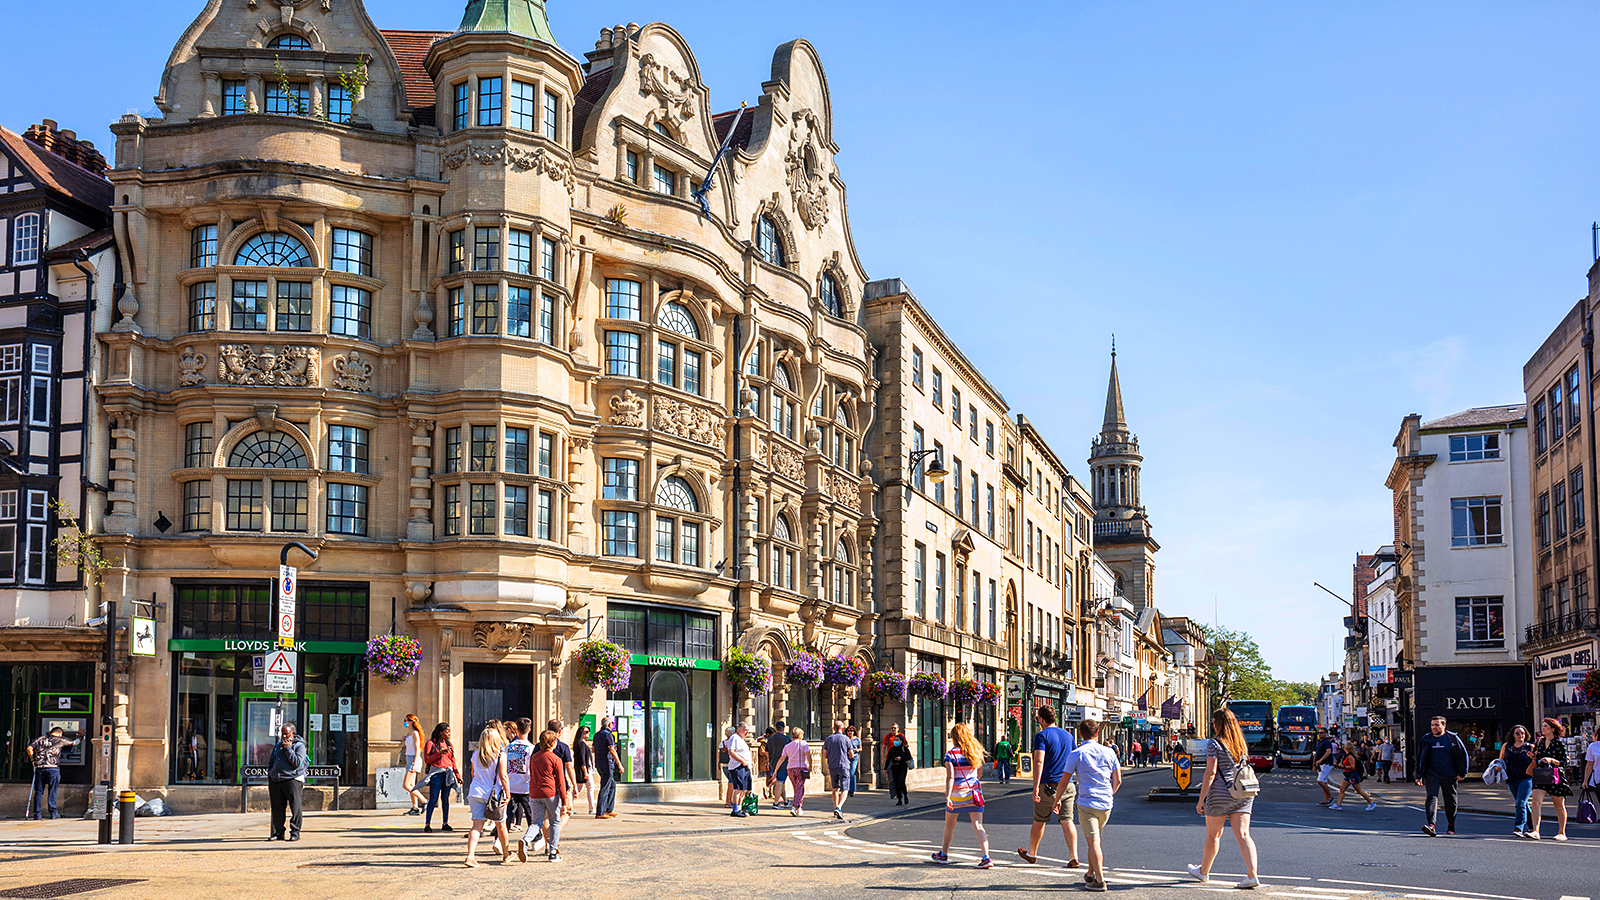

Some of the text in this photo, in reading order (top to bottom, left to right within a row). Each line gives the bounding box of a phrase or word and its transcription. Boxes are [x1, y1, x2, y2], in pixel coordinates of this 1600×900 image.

[224, 640, 270, 650] LLOYDS
[648, 656, 697, 668] LLOYDS BANK
[1446, 696, 1496, 710] PAUL
[306, 768, 334, 776] STREET
